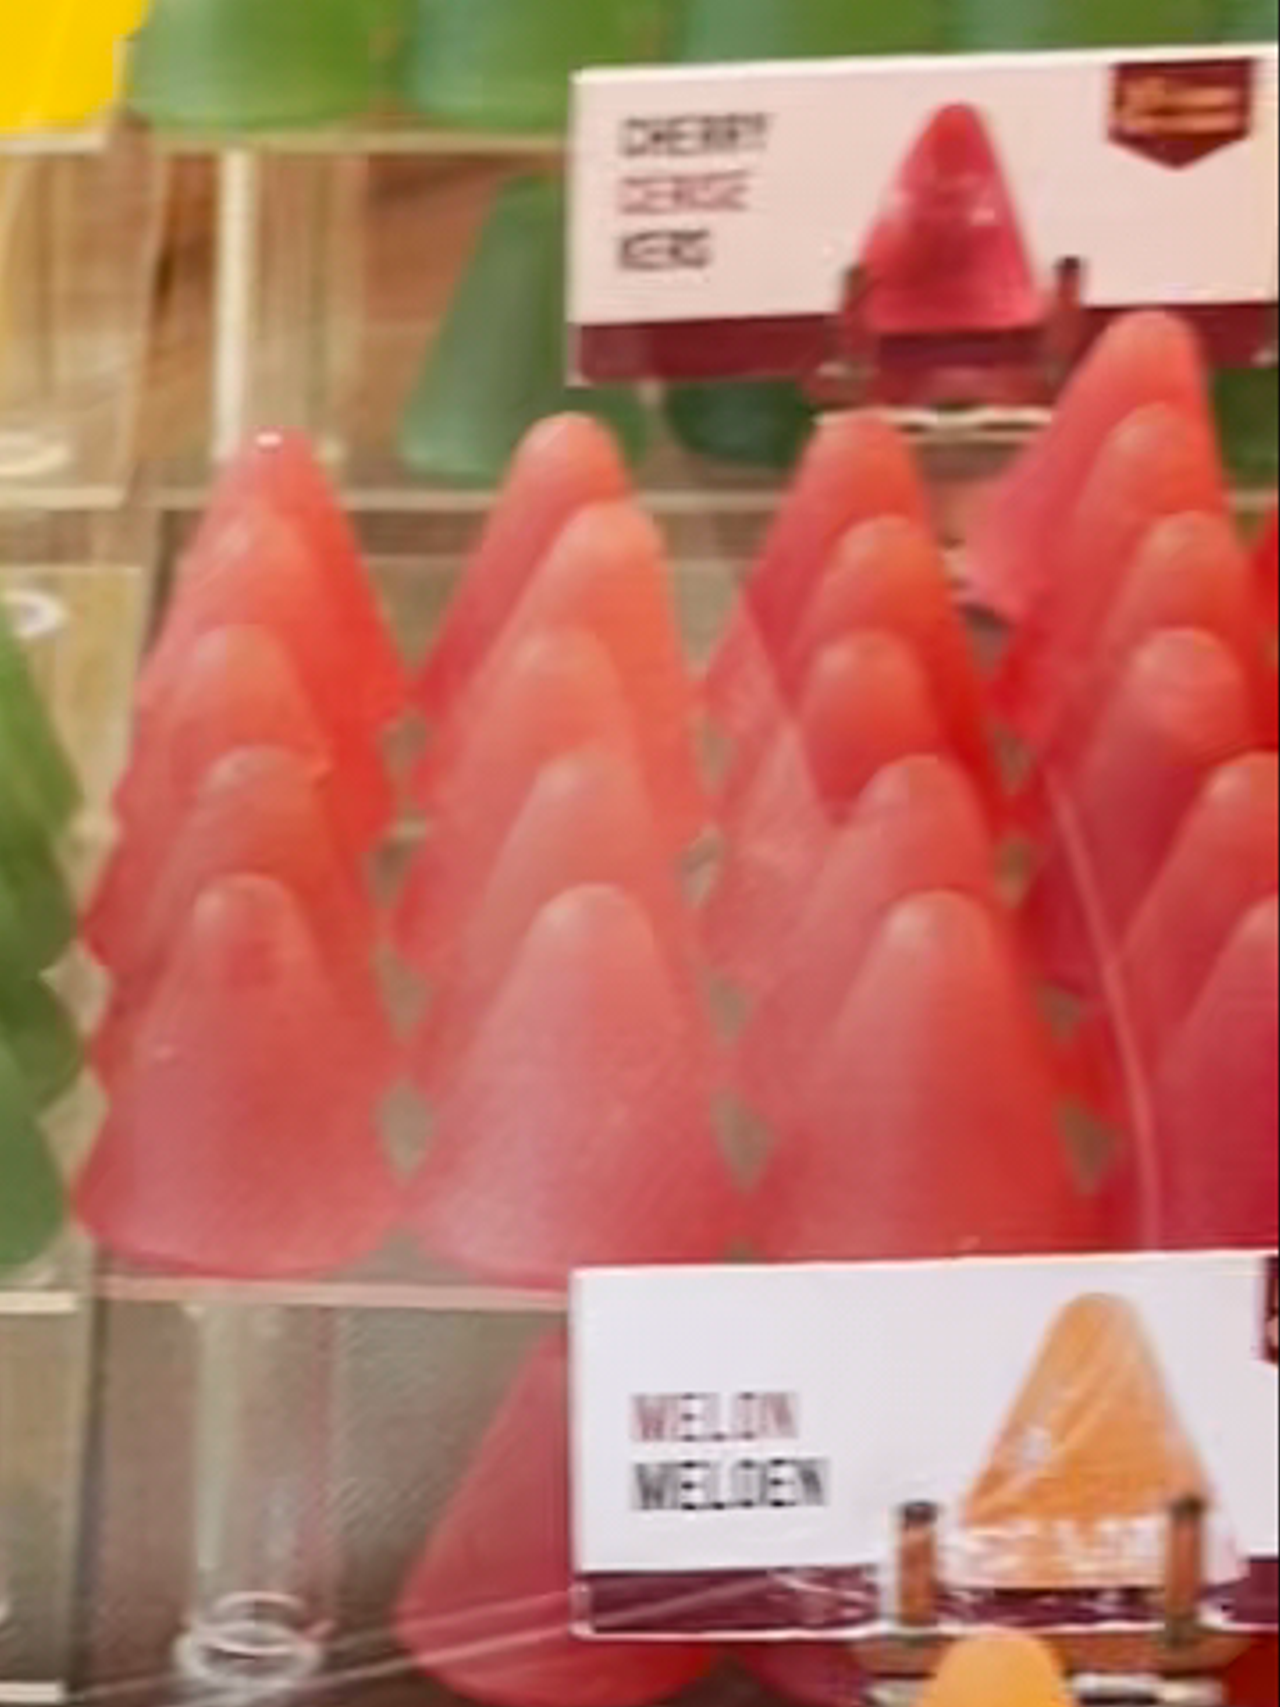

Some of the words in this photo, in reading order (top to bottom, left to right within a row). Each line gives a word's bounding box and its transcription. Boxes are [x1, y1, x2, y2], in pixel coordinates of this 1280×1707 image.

[620, 112, 772, 157] CHERRY
[618, 228, 711, 271] KERS
[632, 1392, 797, 1442] MELON
